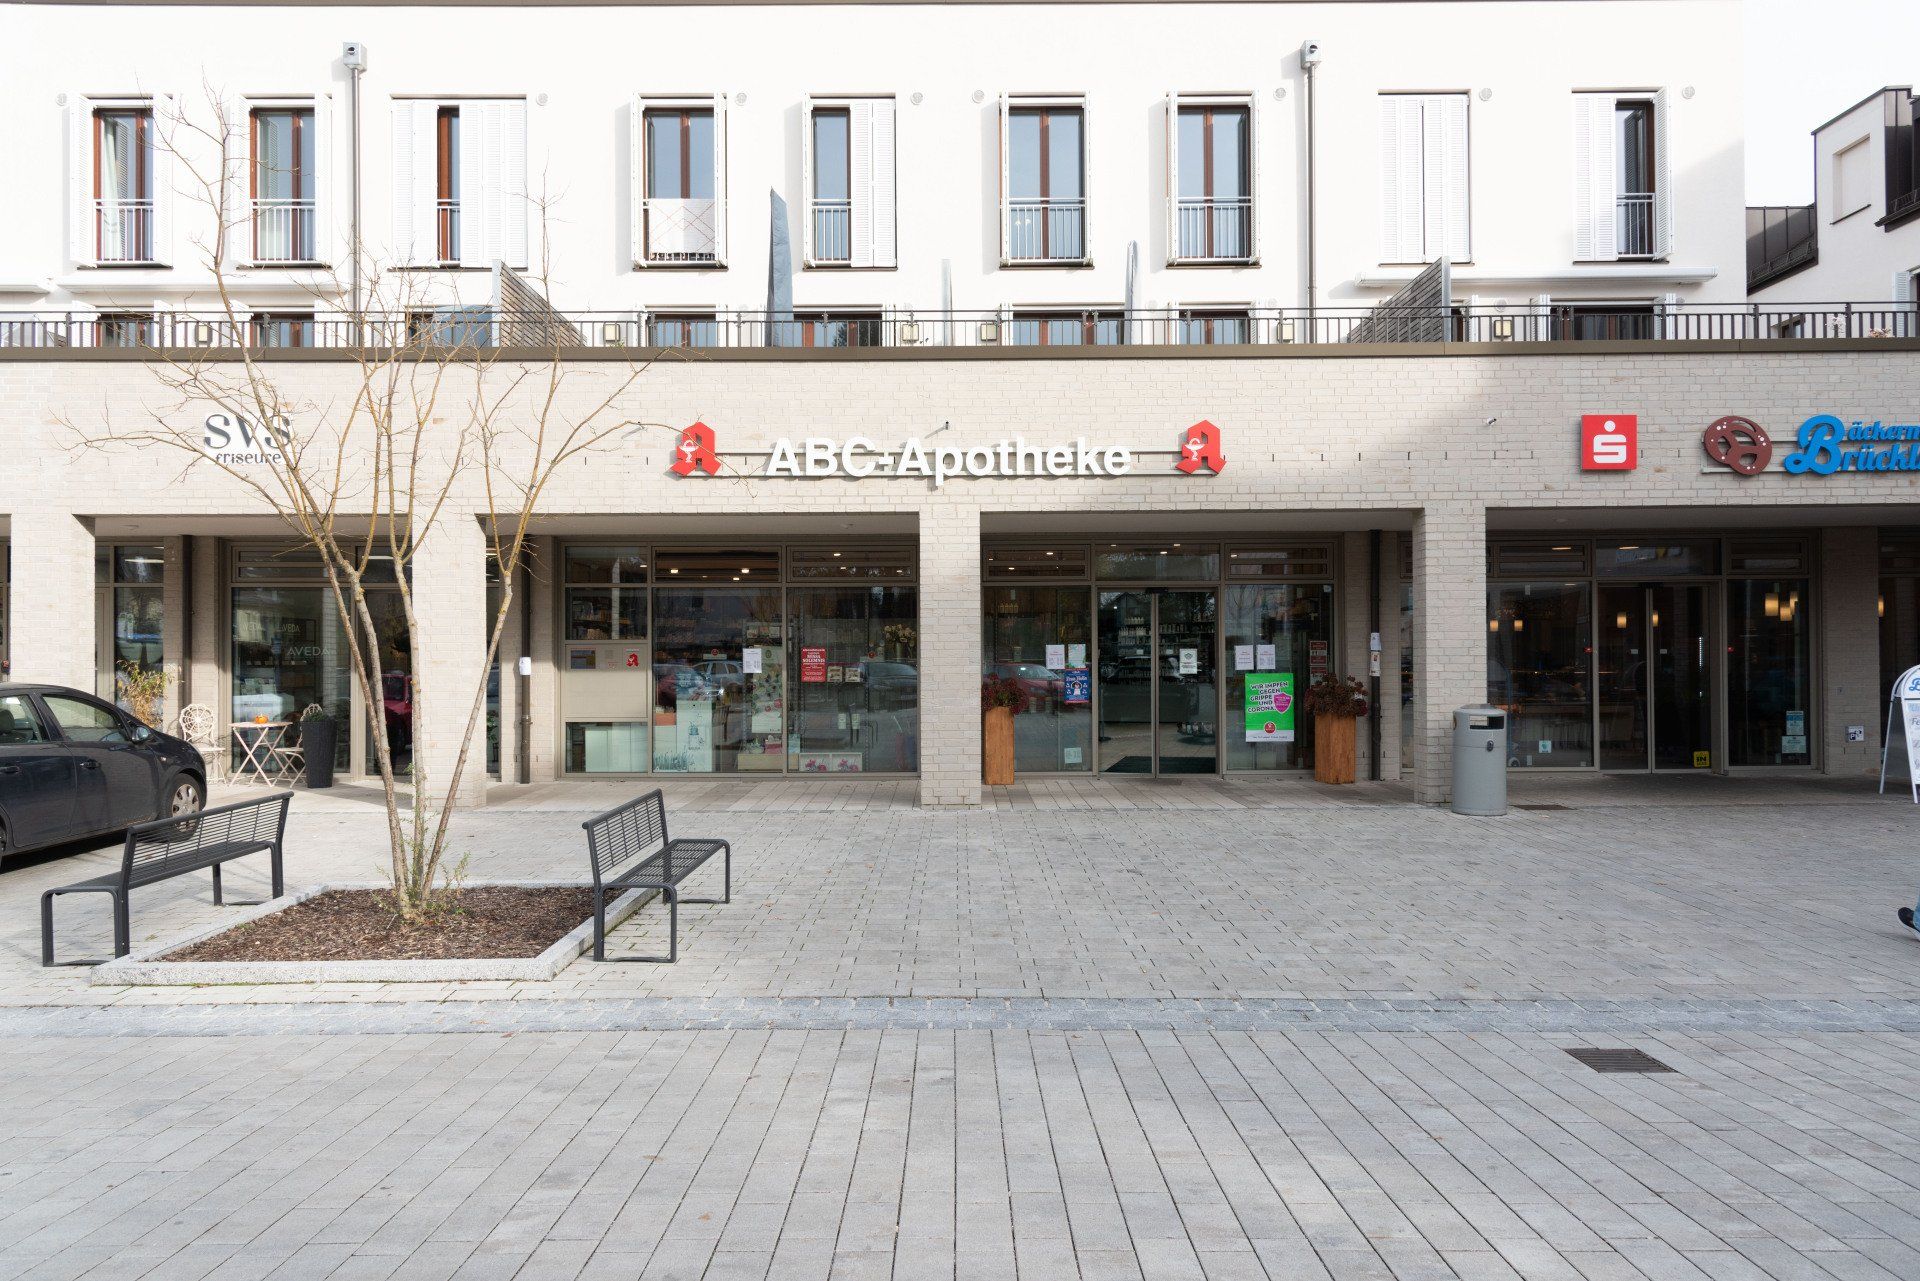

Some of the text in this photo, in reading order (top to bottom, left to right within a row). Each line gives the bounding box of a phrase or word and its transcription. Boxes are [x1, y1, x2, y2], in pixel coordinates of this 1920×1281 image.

[204, 413, 291, 450] SVS
[215, 453, 282, 464] friseure
[766, 435, 1132, 486] ABC-Apotheke
[287, 646, 331, 656] AVEDA
[1264, 681, 1288, 689] IMPFEN
